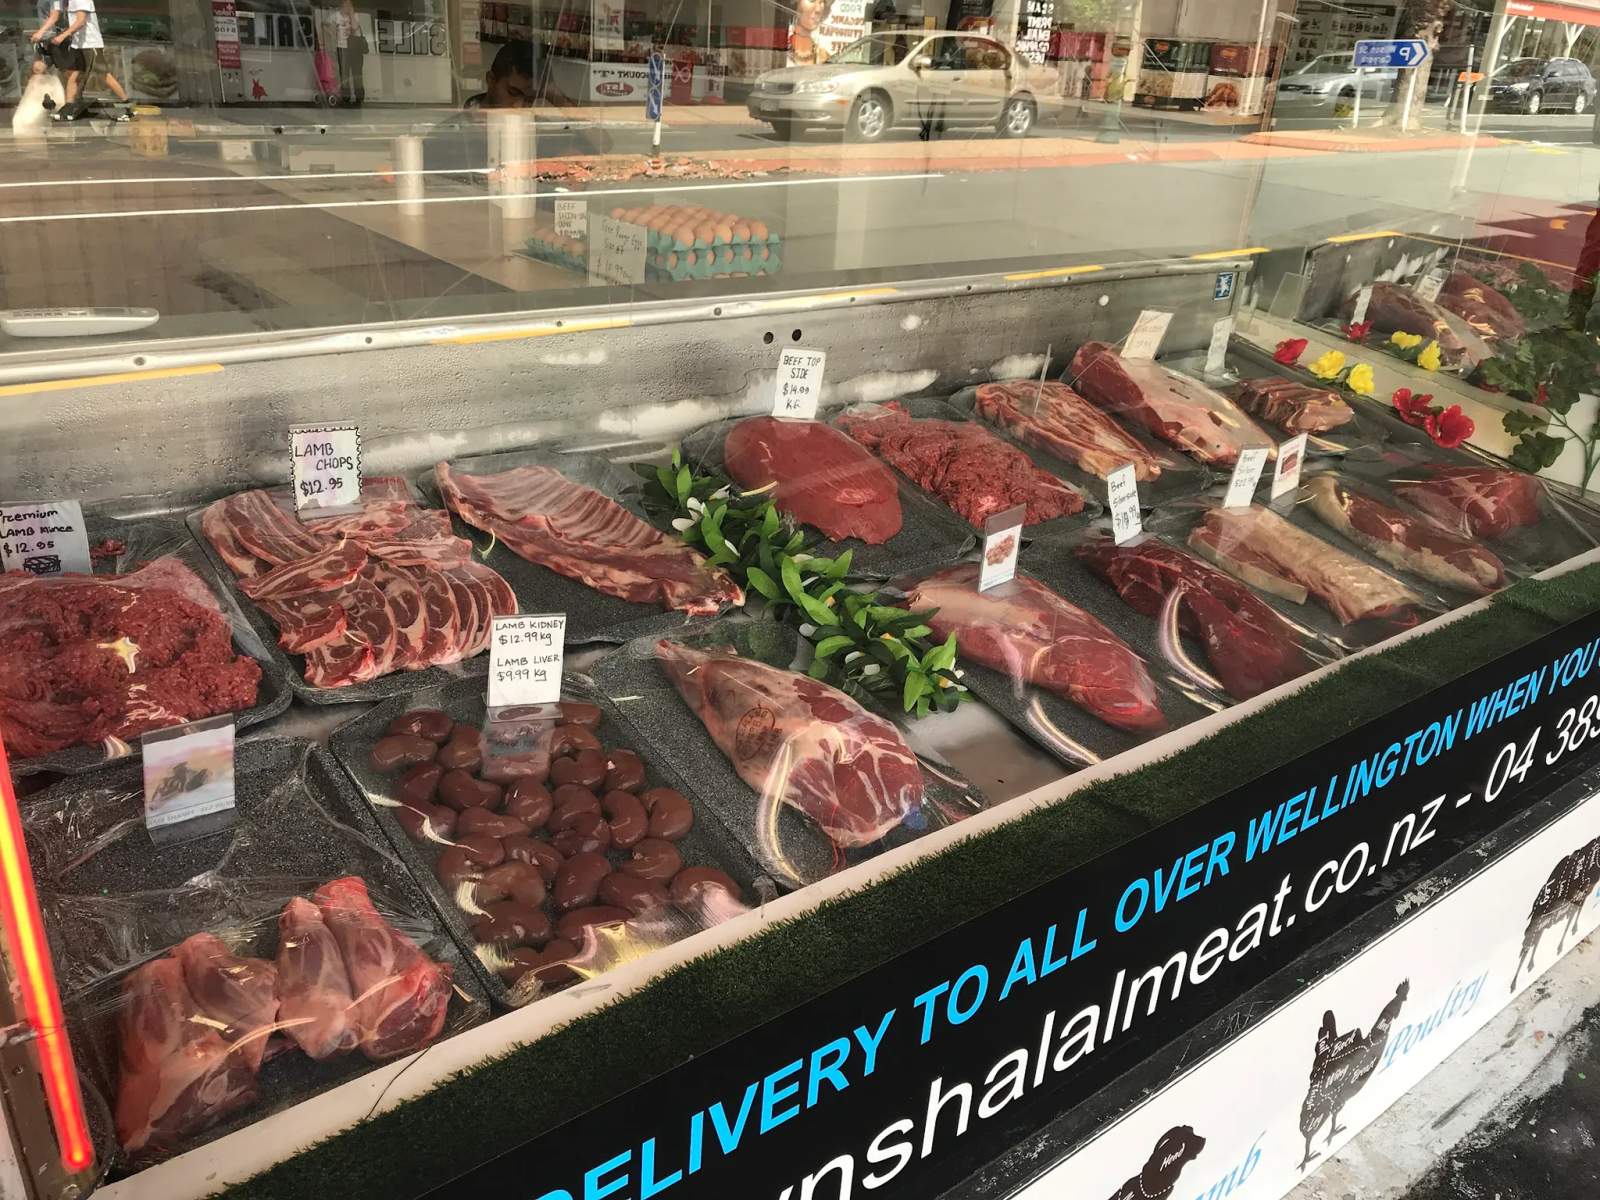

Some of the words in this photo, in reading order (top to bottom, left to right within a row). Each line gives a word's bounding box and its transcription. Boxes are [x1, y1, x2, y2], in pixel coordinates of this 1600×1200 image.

[783, 355, 803, 366] BEEF
[807, 356, 821, 367] TOP
[790, 367, 809, 379] SIDE
[294, 442, 334, 457] LAMB
[315, 456, 354, 471] CHOPS
[300, 477, 343, 497] $12.95
[0, 527, 35, 539] LAMB
[495, 621, 526, 631] LAMB
[529, 620, 564, 630] KIDNEY
[497, 657, 529, 667] LAMB
[533, 653, 560, 665] LIVER
[1485, 726, 1541, 802] 04
[536, 1011, 893, 1200] ELIVERY
[914, 965, 988, 1043] TO
[1001, 910, 1096, 999] ALL
[1115, 832, 1235, 932] OVER
[1246, 712, 1461, 861] WELLINGTON
[1466, 665, 1548, 737] WHEN
[1378, 970, 1489, 1076] Poultry
